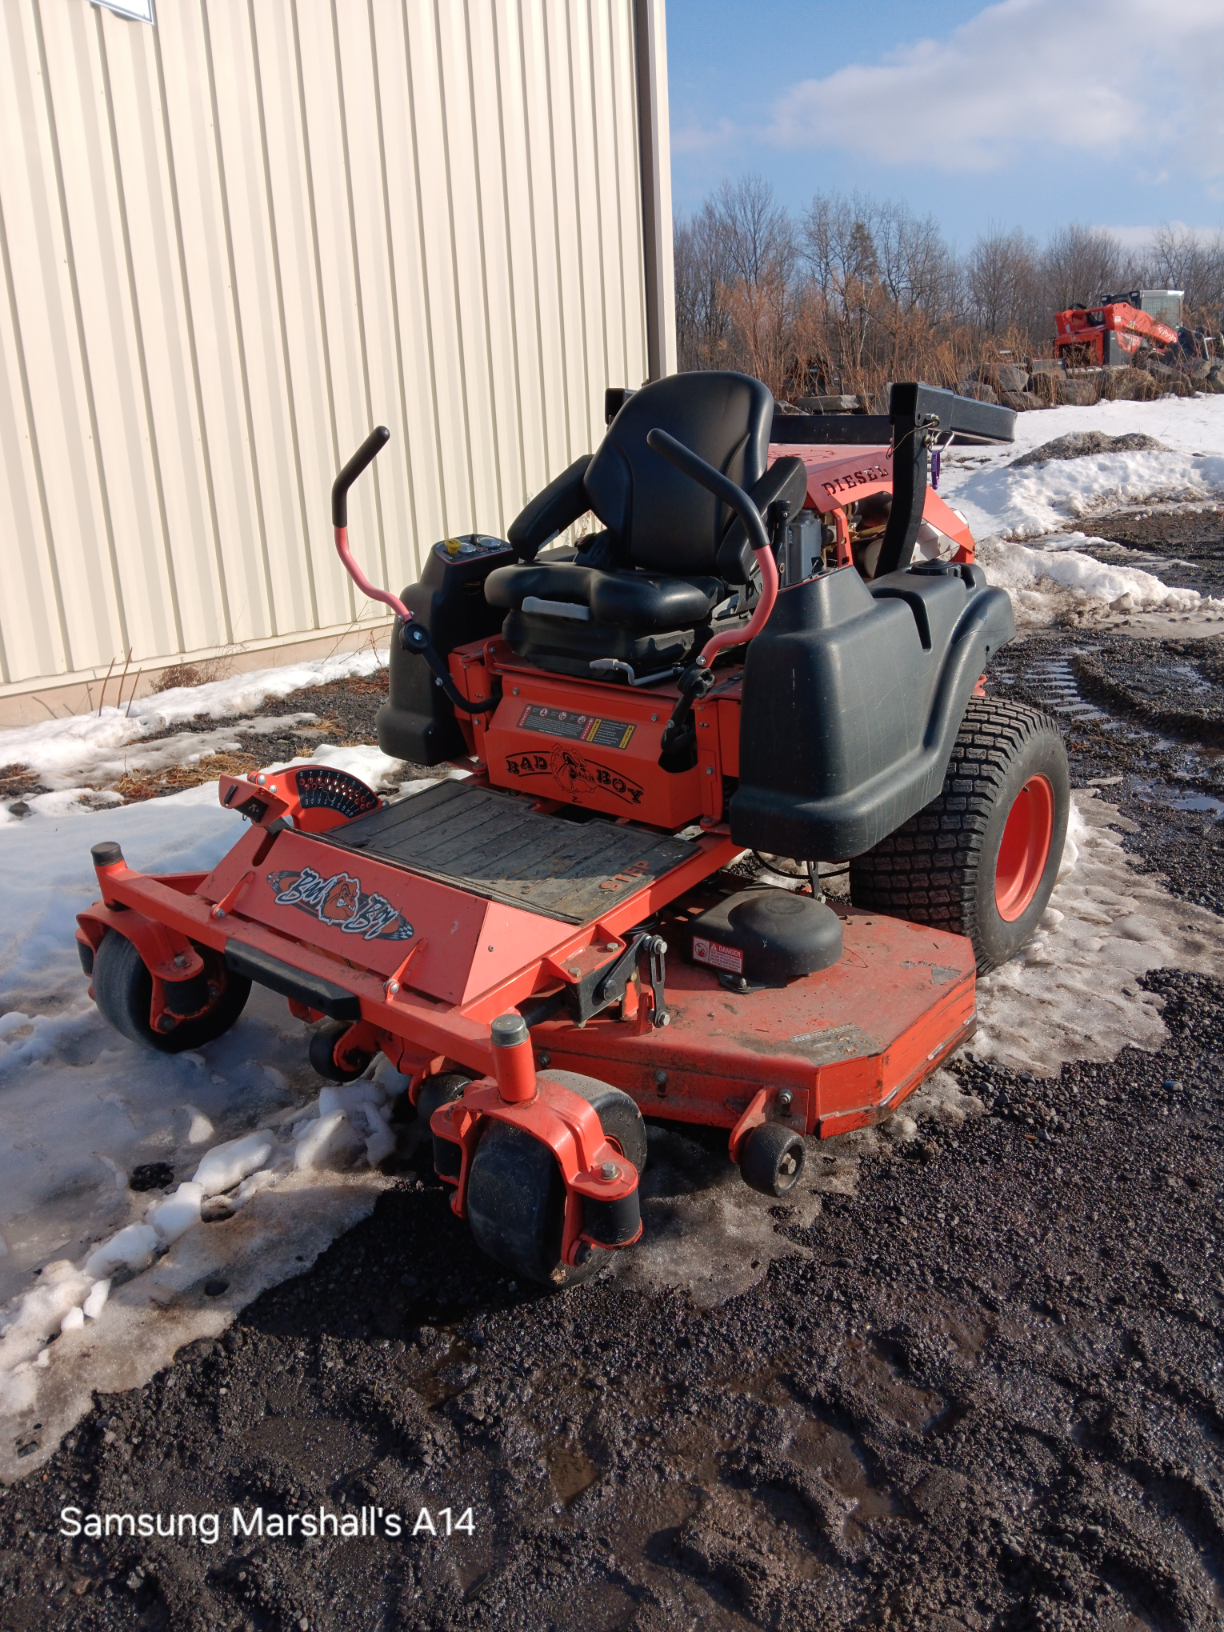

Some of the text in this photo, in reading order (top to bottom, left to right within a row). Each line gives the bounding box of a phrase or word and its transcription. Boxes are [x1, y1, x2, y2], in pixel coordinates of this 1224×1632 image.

[821, 465, 889, 497] DIESEL
[506, 755, 643, 804] BAD BOY
[600, 861, 650, 892] STEP
[342, 893, 400, 940] Boy
[718, 945, 741, 958] DANGER
